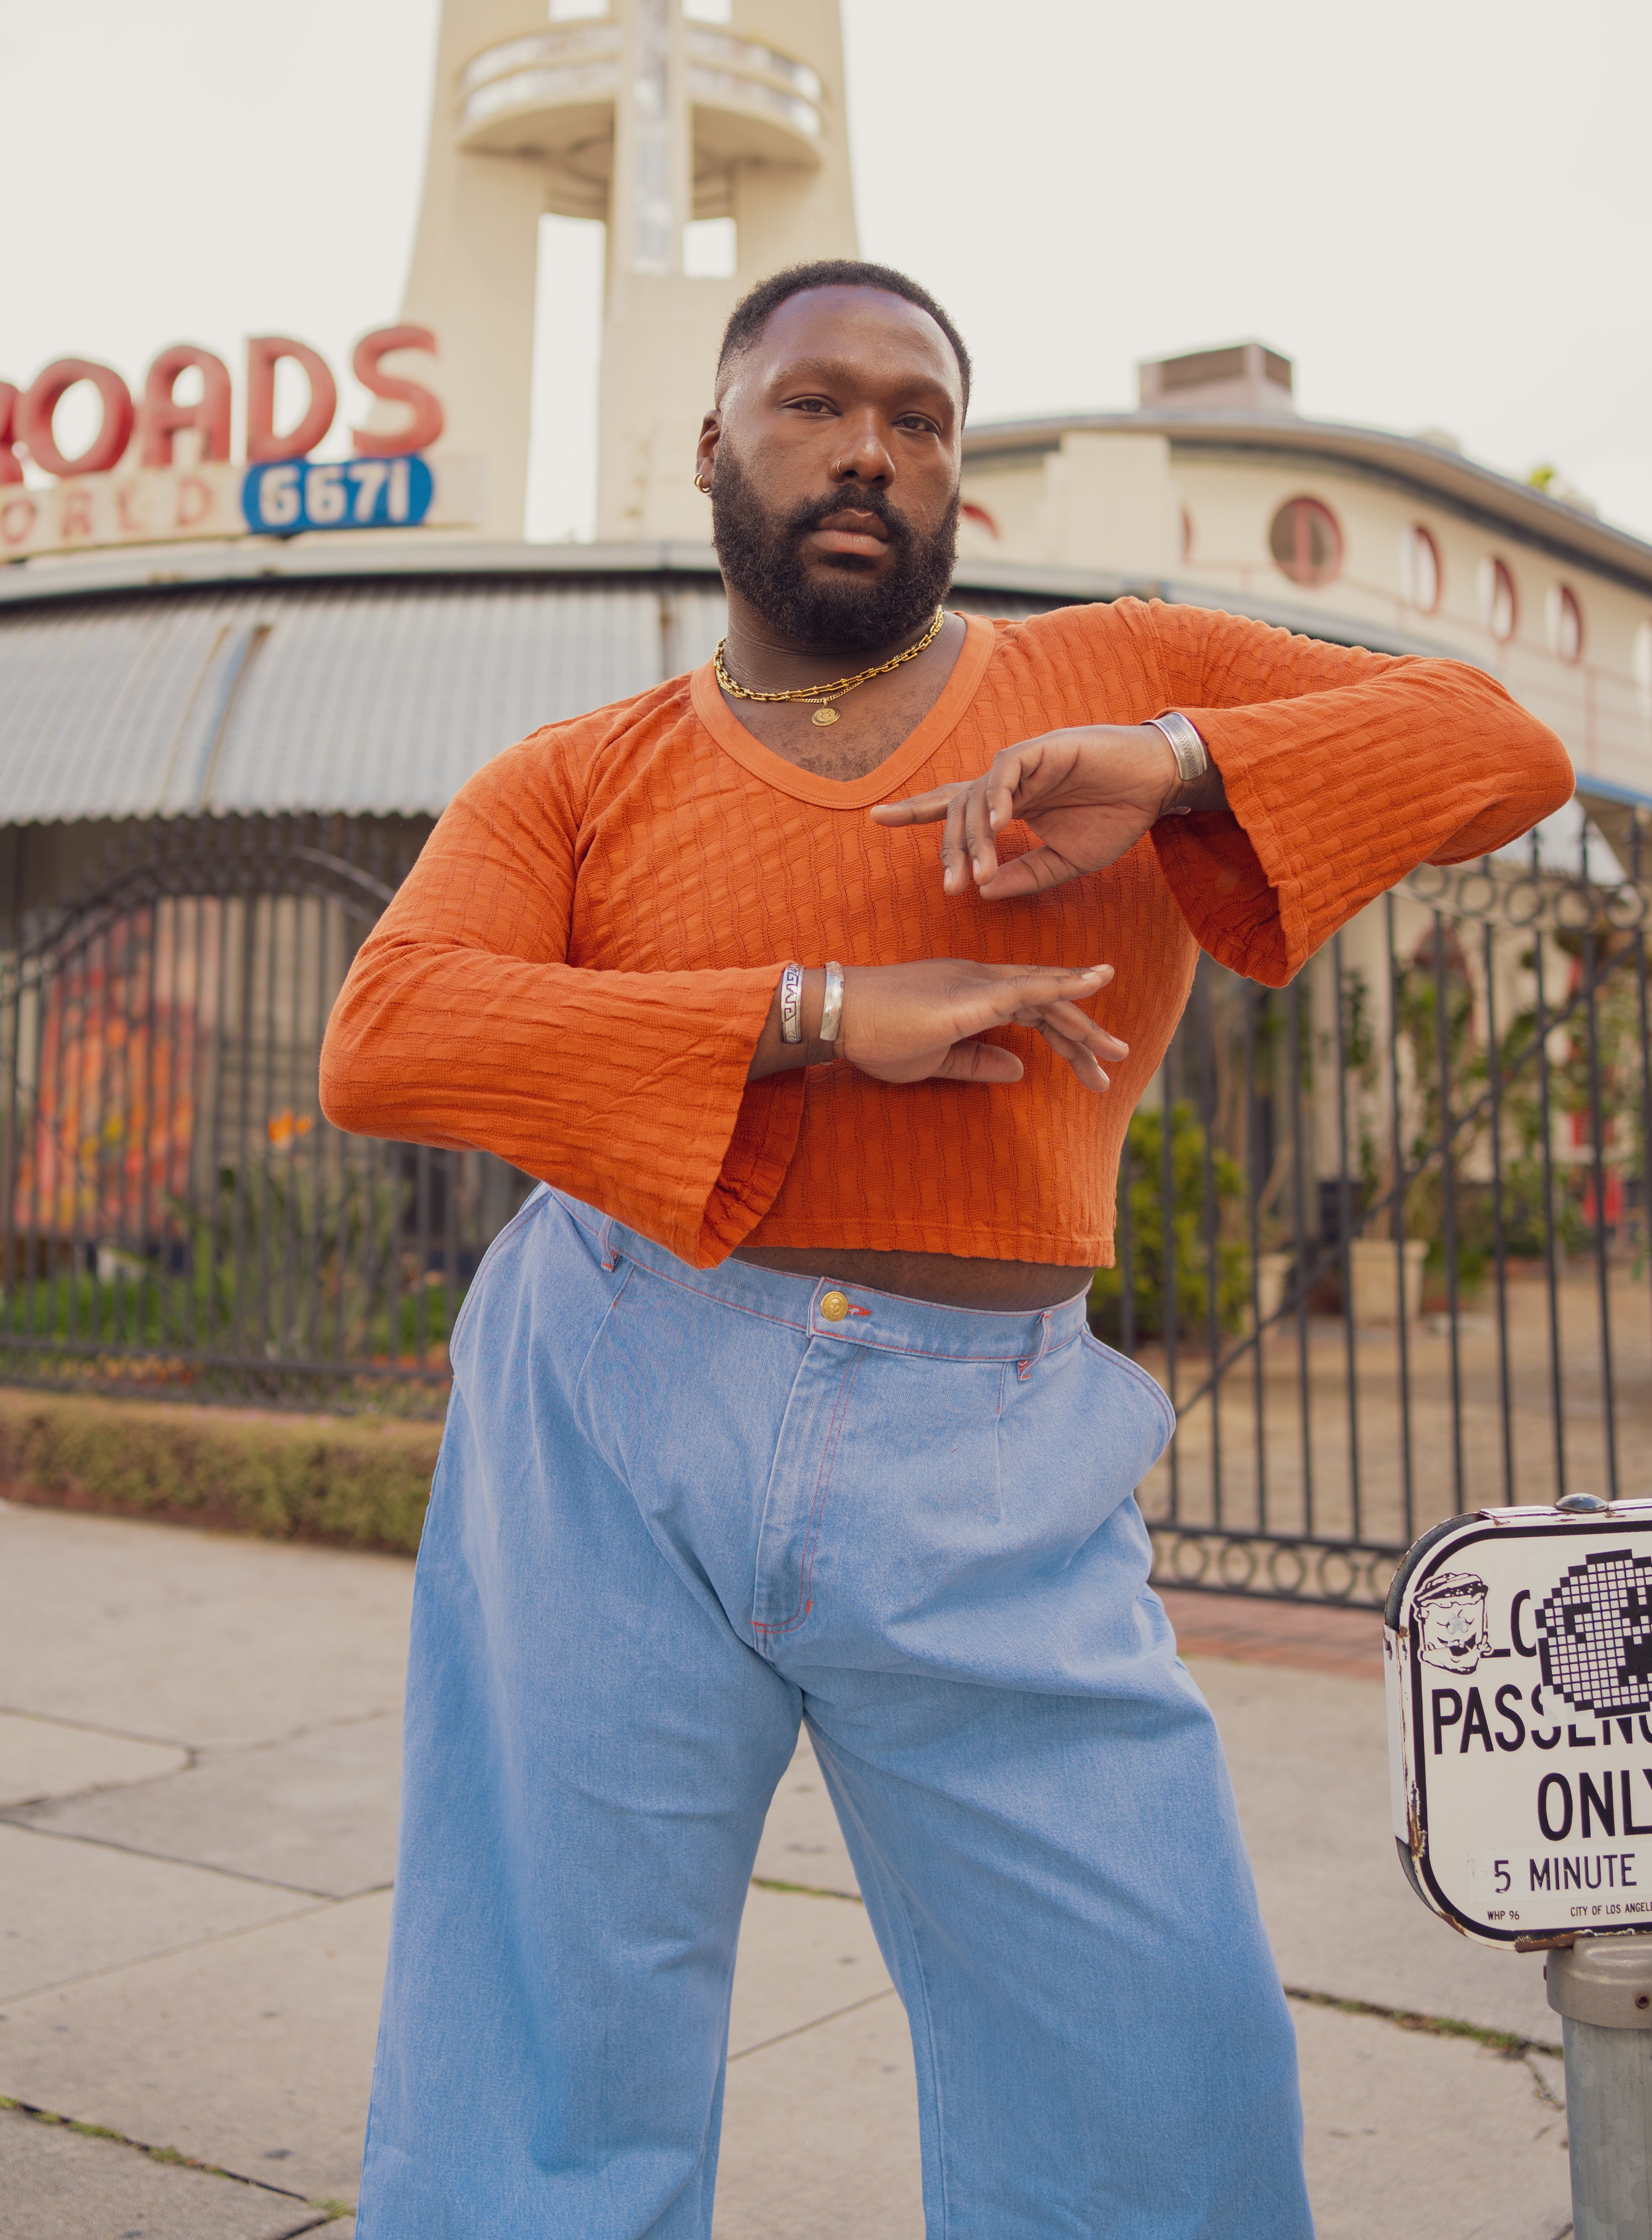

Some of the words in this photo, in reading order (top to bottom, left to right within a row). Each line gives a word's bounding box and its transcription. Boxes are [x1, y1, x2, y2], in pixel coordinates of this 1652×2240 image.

[0, 325, 444, 485] OADS
[258, 460, 410, 526] 6671
[1537, 1768, 1652, 1841] ONL
[1494, 1859, 1511, 1894] 5
[1529, 1853, 1637, 1891] MINUTE
[1487, 1910, 1506, 1921] WHP
[1509, 1910, 1520, 1920] 96
[1570, 1906, 1588, 1917] CITY
[1592, 1905, 1602, 1916] OF
[1606, 1904, 1621, 1915] LOS
[1625, 1901, 1652, 1913] ANGEL
